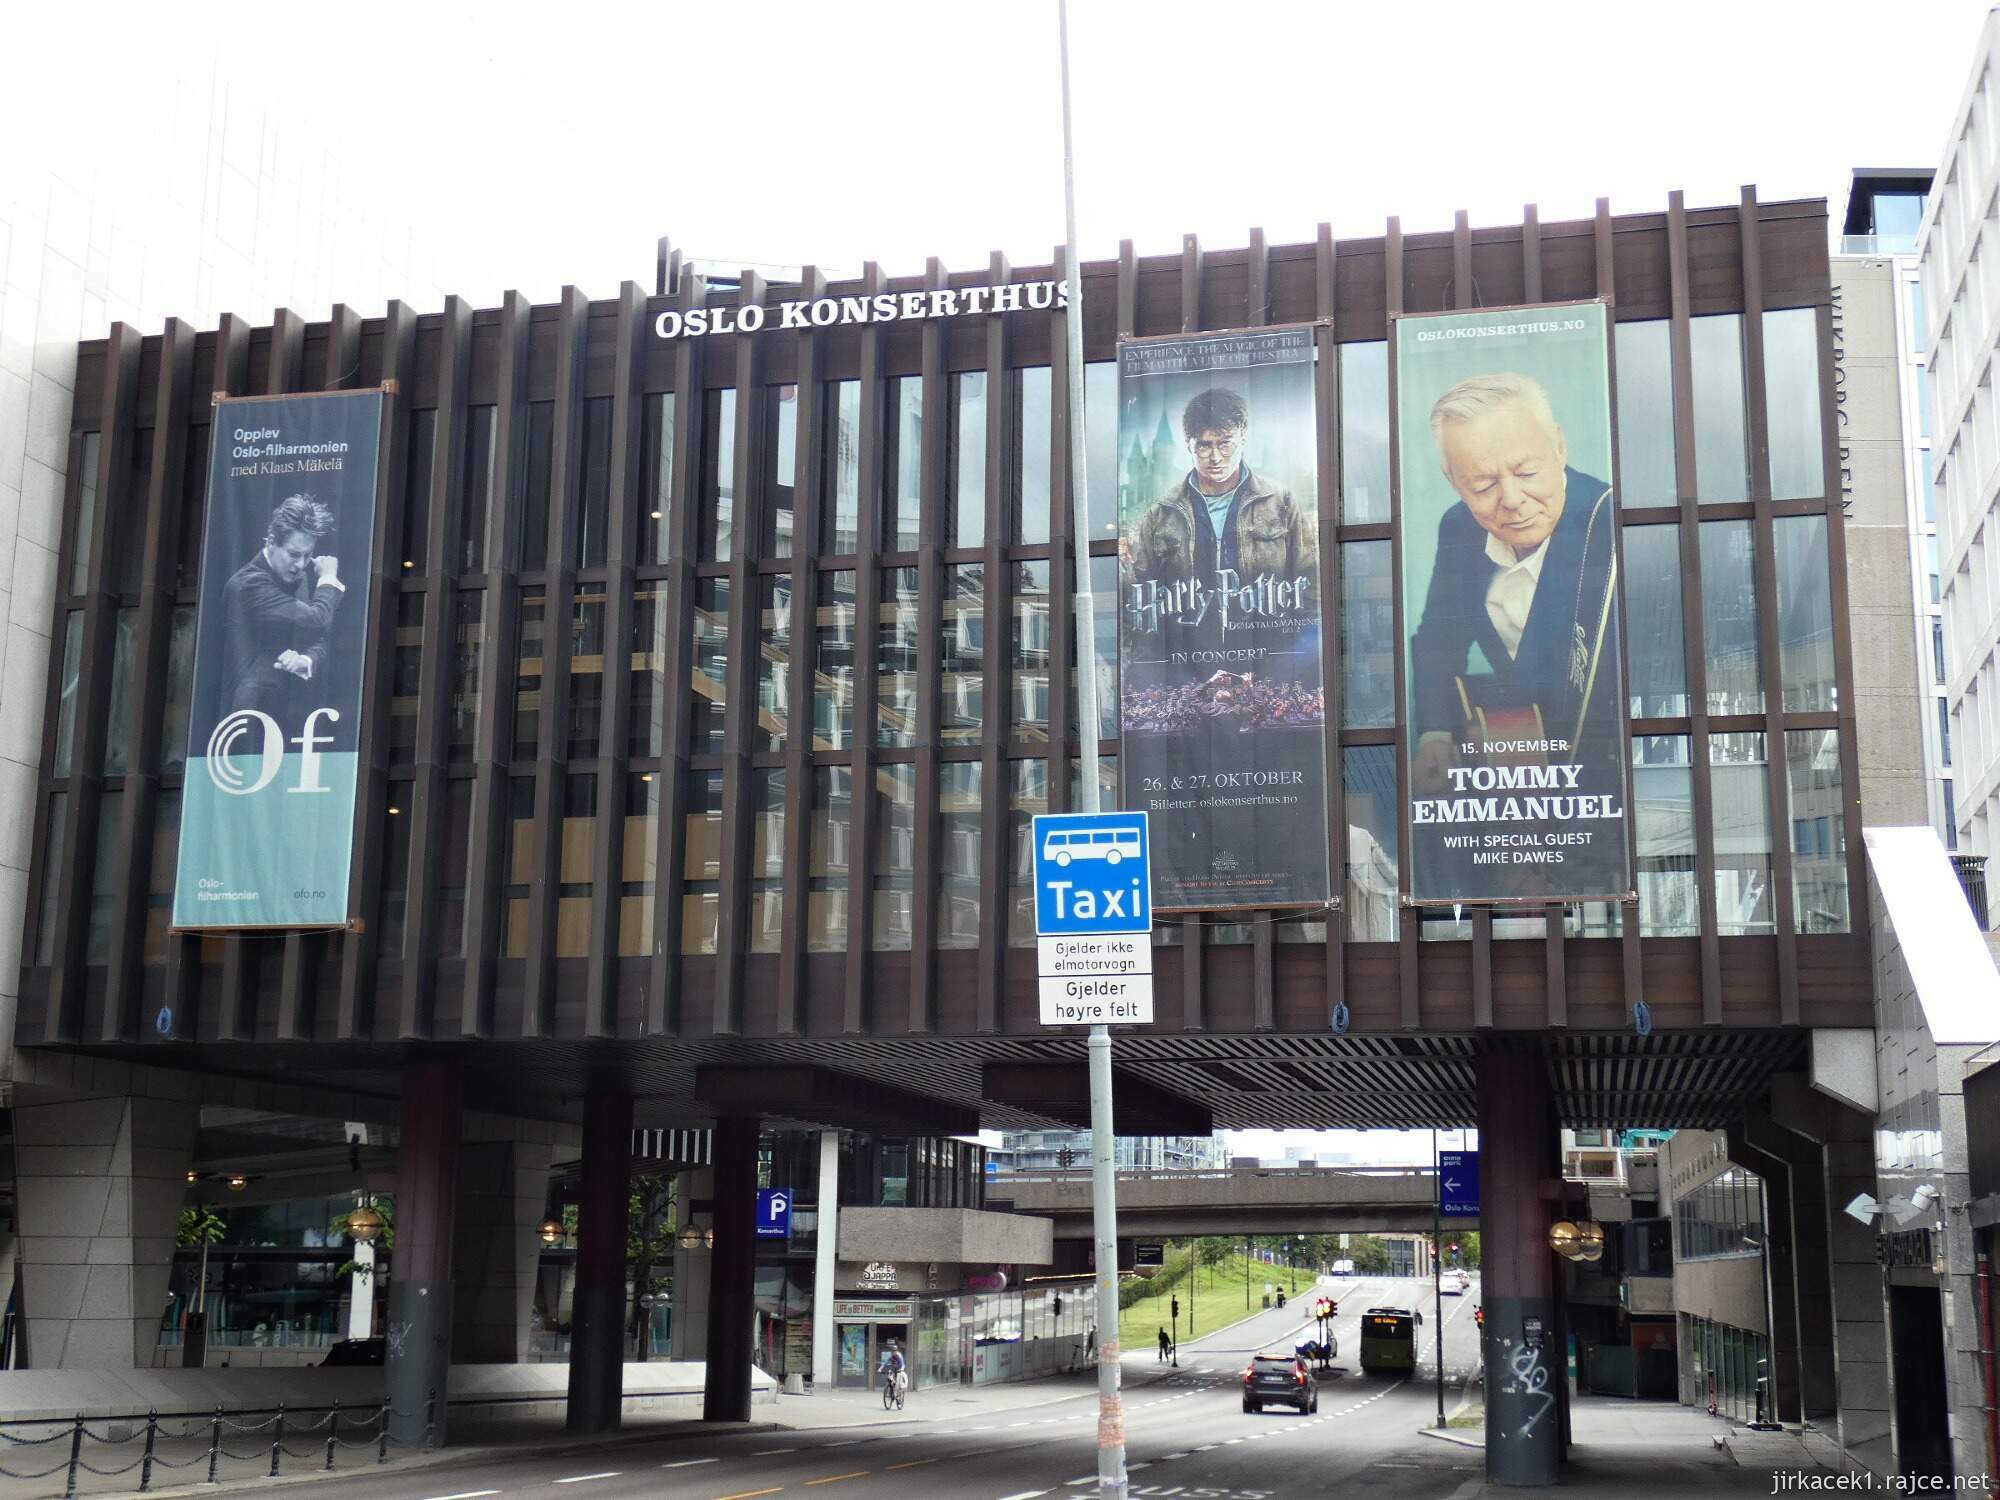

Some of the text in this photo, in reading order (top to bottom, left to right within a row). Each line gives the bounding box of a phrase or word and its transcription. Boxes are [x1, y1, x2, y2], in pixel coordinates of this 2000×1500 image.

[655, 304, 764, 338] OSLO
[1417, 320, 1585, 342] OSLOKONSERTHUS.NO
[1199, 344, 1218, 354] THE
[1262, 338, 1277, 348] OF
[1280, 336, 1304, 347] THE
[234, 427, 280, 444] Opplev
[232, 441, 348, 459] Oslo-filharmonien
[231, 458, 343, 477] med Klaus Mäkelä
[1125, 569, 1310, 644] Harry Potter
[1171, 647, 1267, 665] IN CONCERT
[206, 707, 340, 795] Of
[1461, 739, 1568, 754] 15. NOVEMBER
[1143, 771, 1304, 792] 26. & 27. OKTOBER
[1447, 764, 1583, 792] TOMMY
[1150, 794, 1298, 810] Billetter: oslokonserthus.no
[1412, 794, 1623, 824] EMMANUEL
[1443, 832, 1592, 849] WITH SPECIAL GUEST
[1473, 851, 1564, 865] MIKE DAWES
[293, 888, 326, 899] ofo.no
[1046, 877, 1141, 920] Taxi
[1056, 941, 1134, 958] Gjelder ikke
[1055, 958, 1135, 972] elmotorvogn
[1066, 981, 1126, 1000] Gjelder
[1056, 1002, 1138, 1021] høyre felt
[770, 1199, 786, 1221] P
[1444, 1204, 1462, 1212] Oslo
